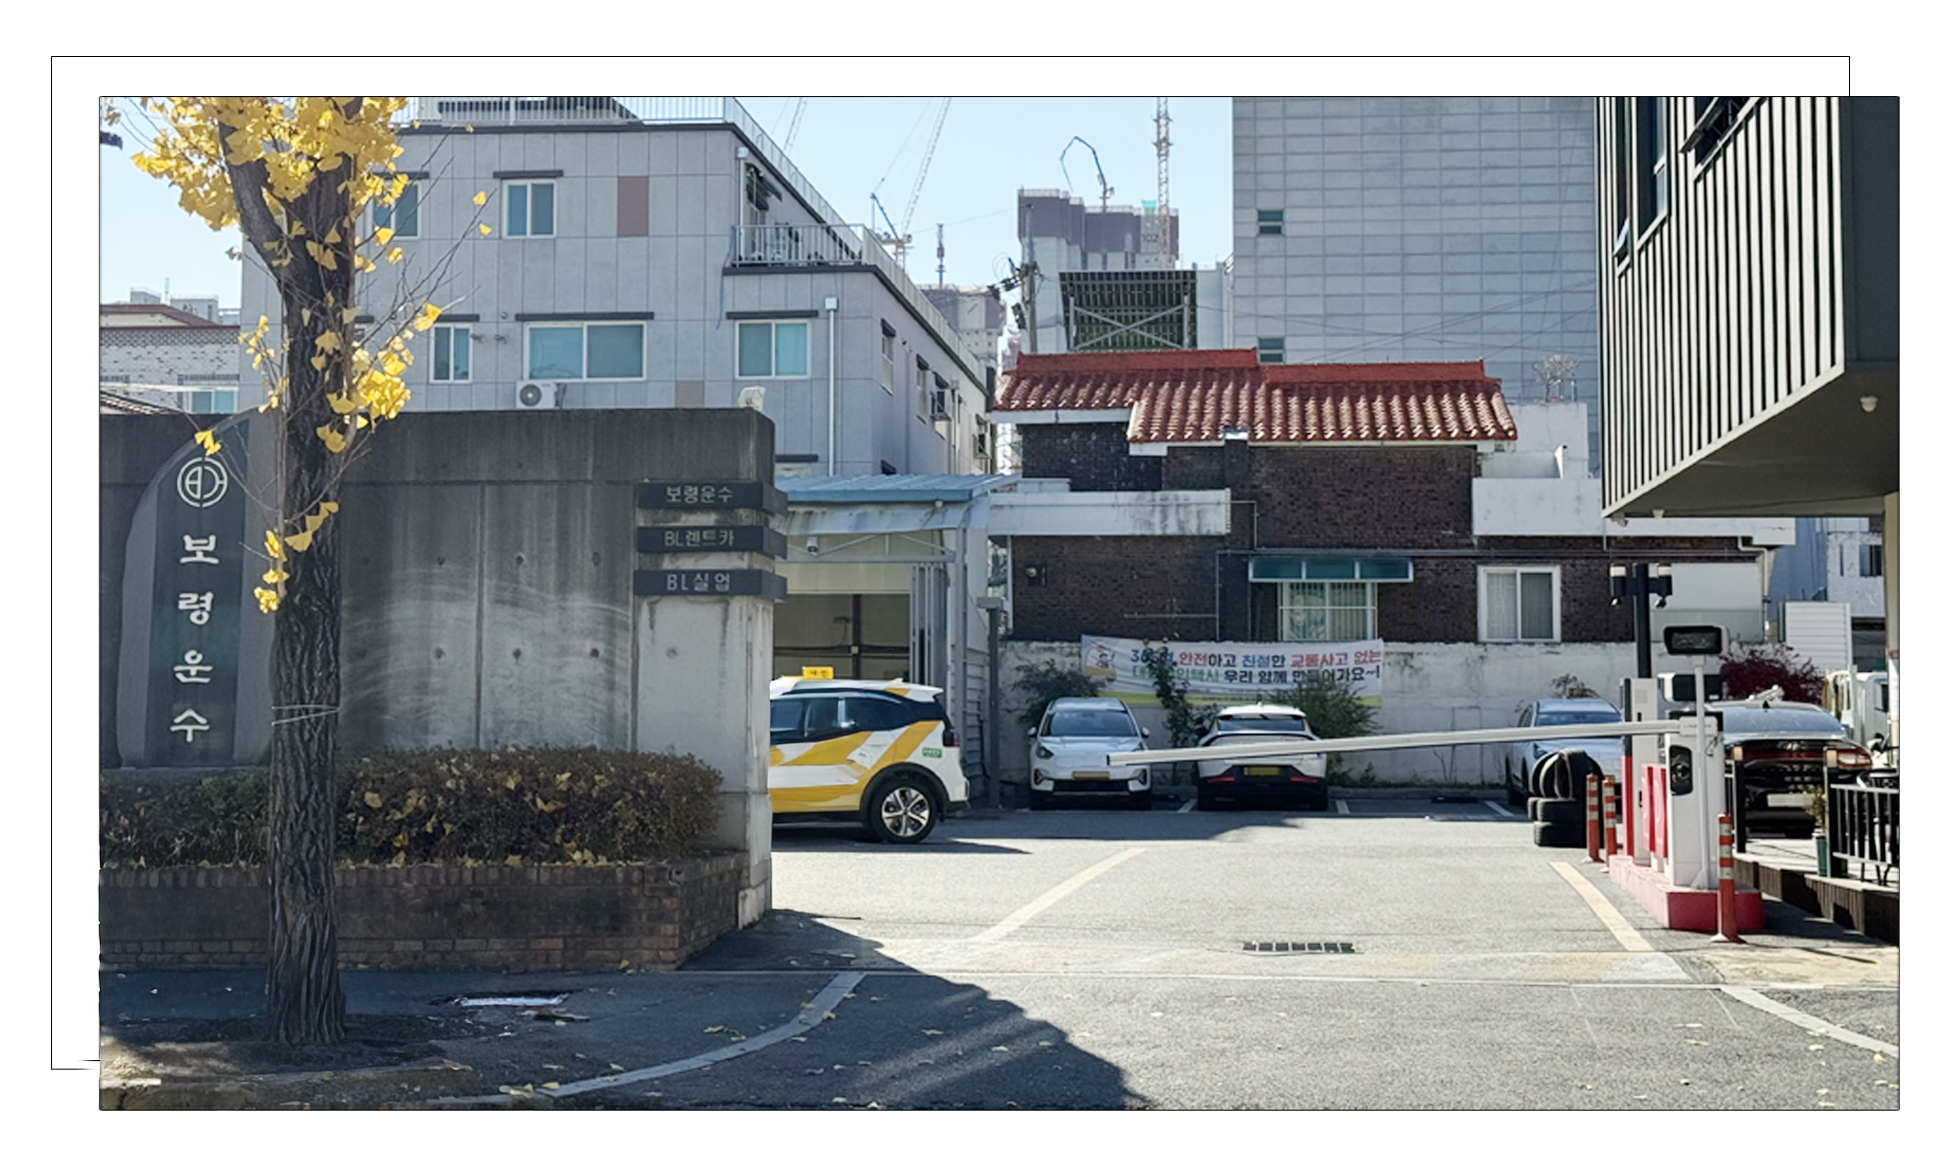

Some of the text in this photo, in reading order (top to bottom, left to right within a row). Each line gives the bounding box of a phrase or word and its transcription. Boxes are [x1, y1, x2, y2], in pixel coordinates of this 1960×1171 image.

[665, 485, 734, 504] 보령운수
[664, 529, 735, 547] BL렌트카
[169, 533, 221, 743] 보령운수
[1241, 653, 1286, 668] 친절한
[1291, 652, 1349, 668] 교통사고
[1354, 649, 1381, 666] 없는
[1224, 669, 1253, 683] 우리
[1258, 670, 1288, 684] 함께
